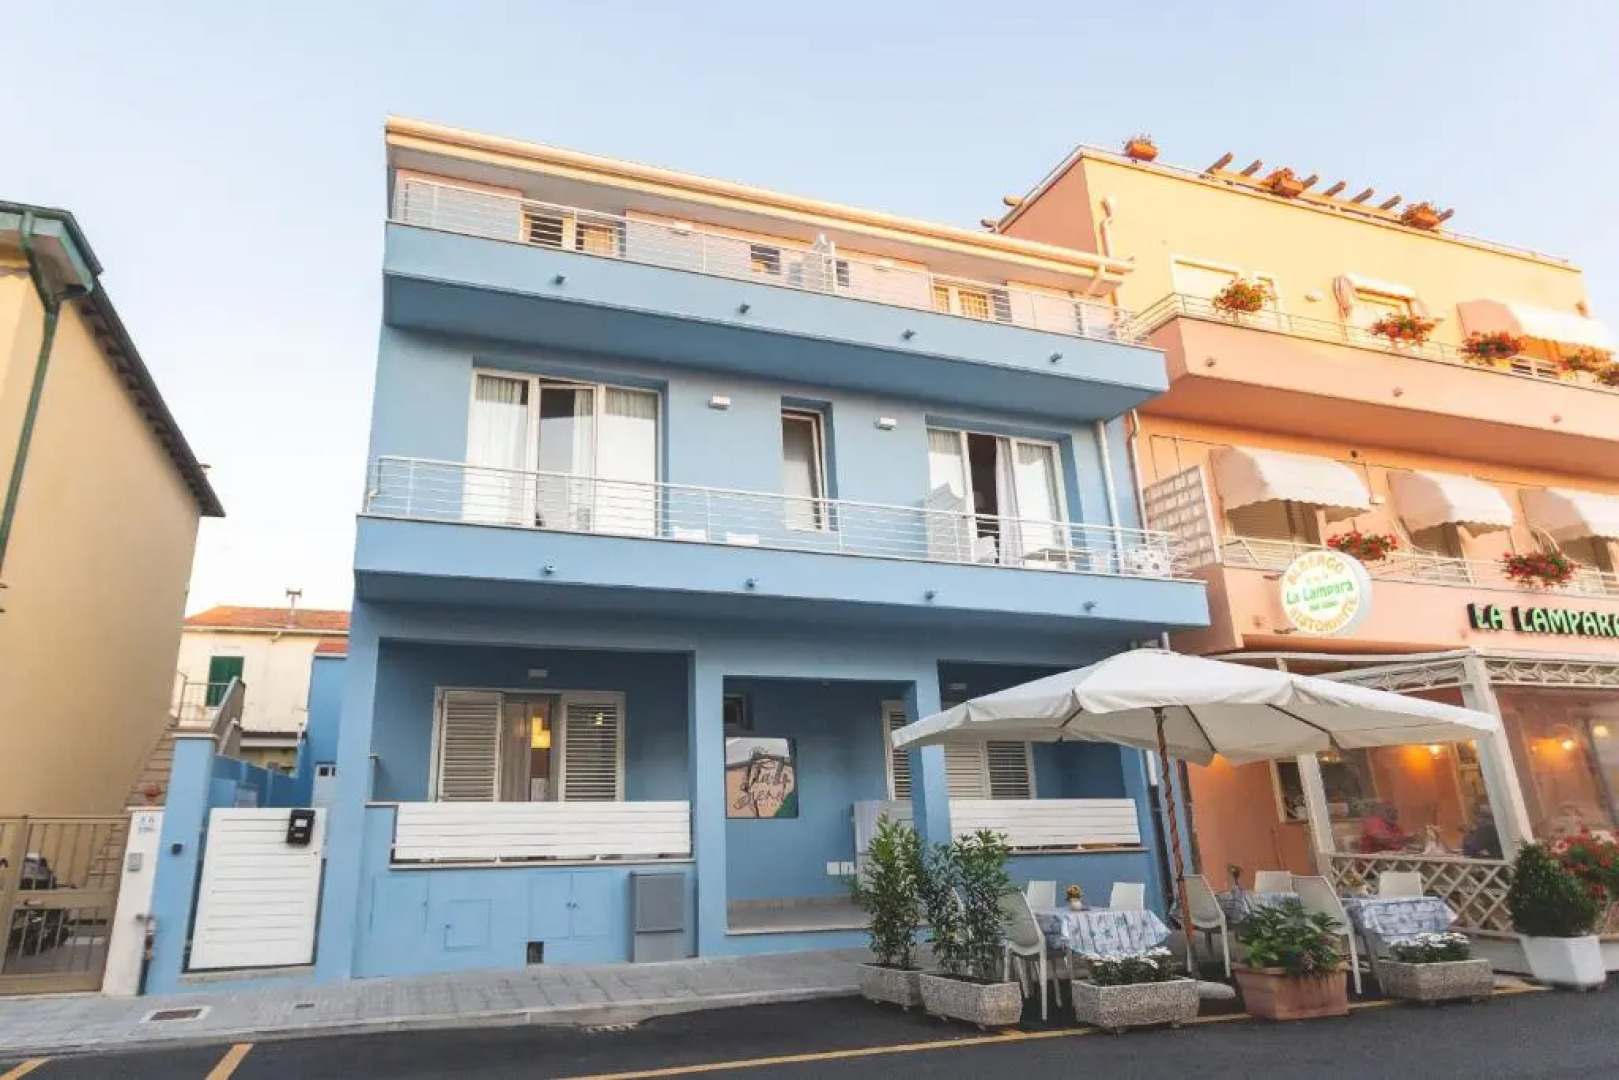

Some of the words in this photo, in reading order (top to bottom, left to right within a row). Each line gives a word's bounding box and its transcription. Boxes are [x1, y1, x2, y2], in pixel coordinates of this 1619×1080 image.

[1286, 591, 1300, 605] La
[1302, 581, 1354, 601] Lampara
[1467, 603, 1503, 629] LA
